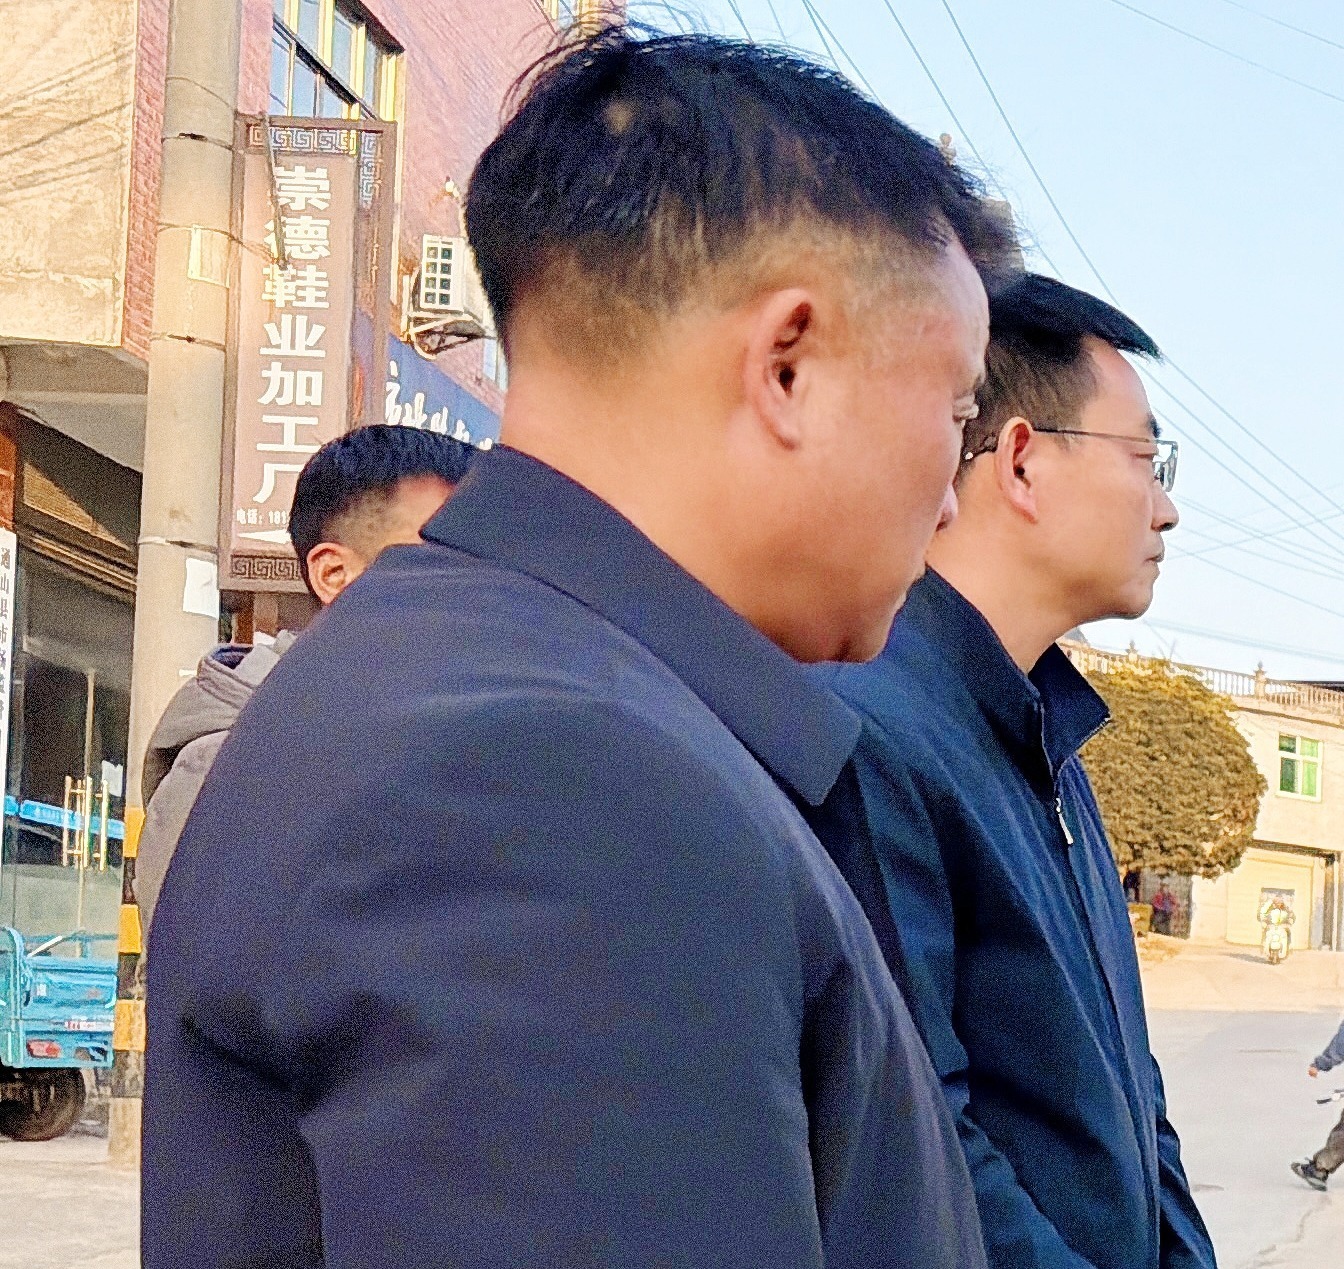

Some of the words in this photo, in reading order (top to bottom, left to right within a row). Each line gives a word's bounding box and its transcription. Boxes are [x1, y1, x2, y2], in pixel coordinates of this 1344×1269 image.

[252, 165, 332, 504] 崇德鞋业加工厂
